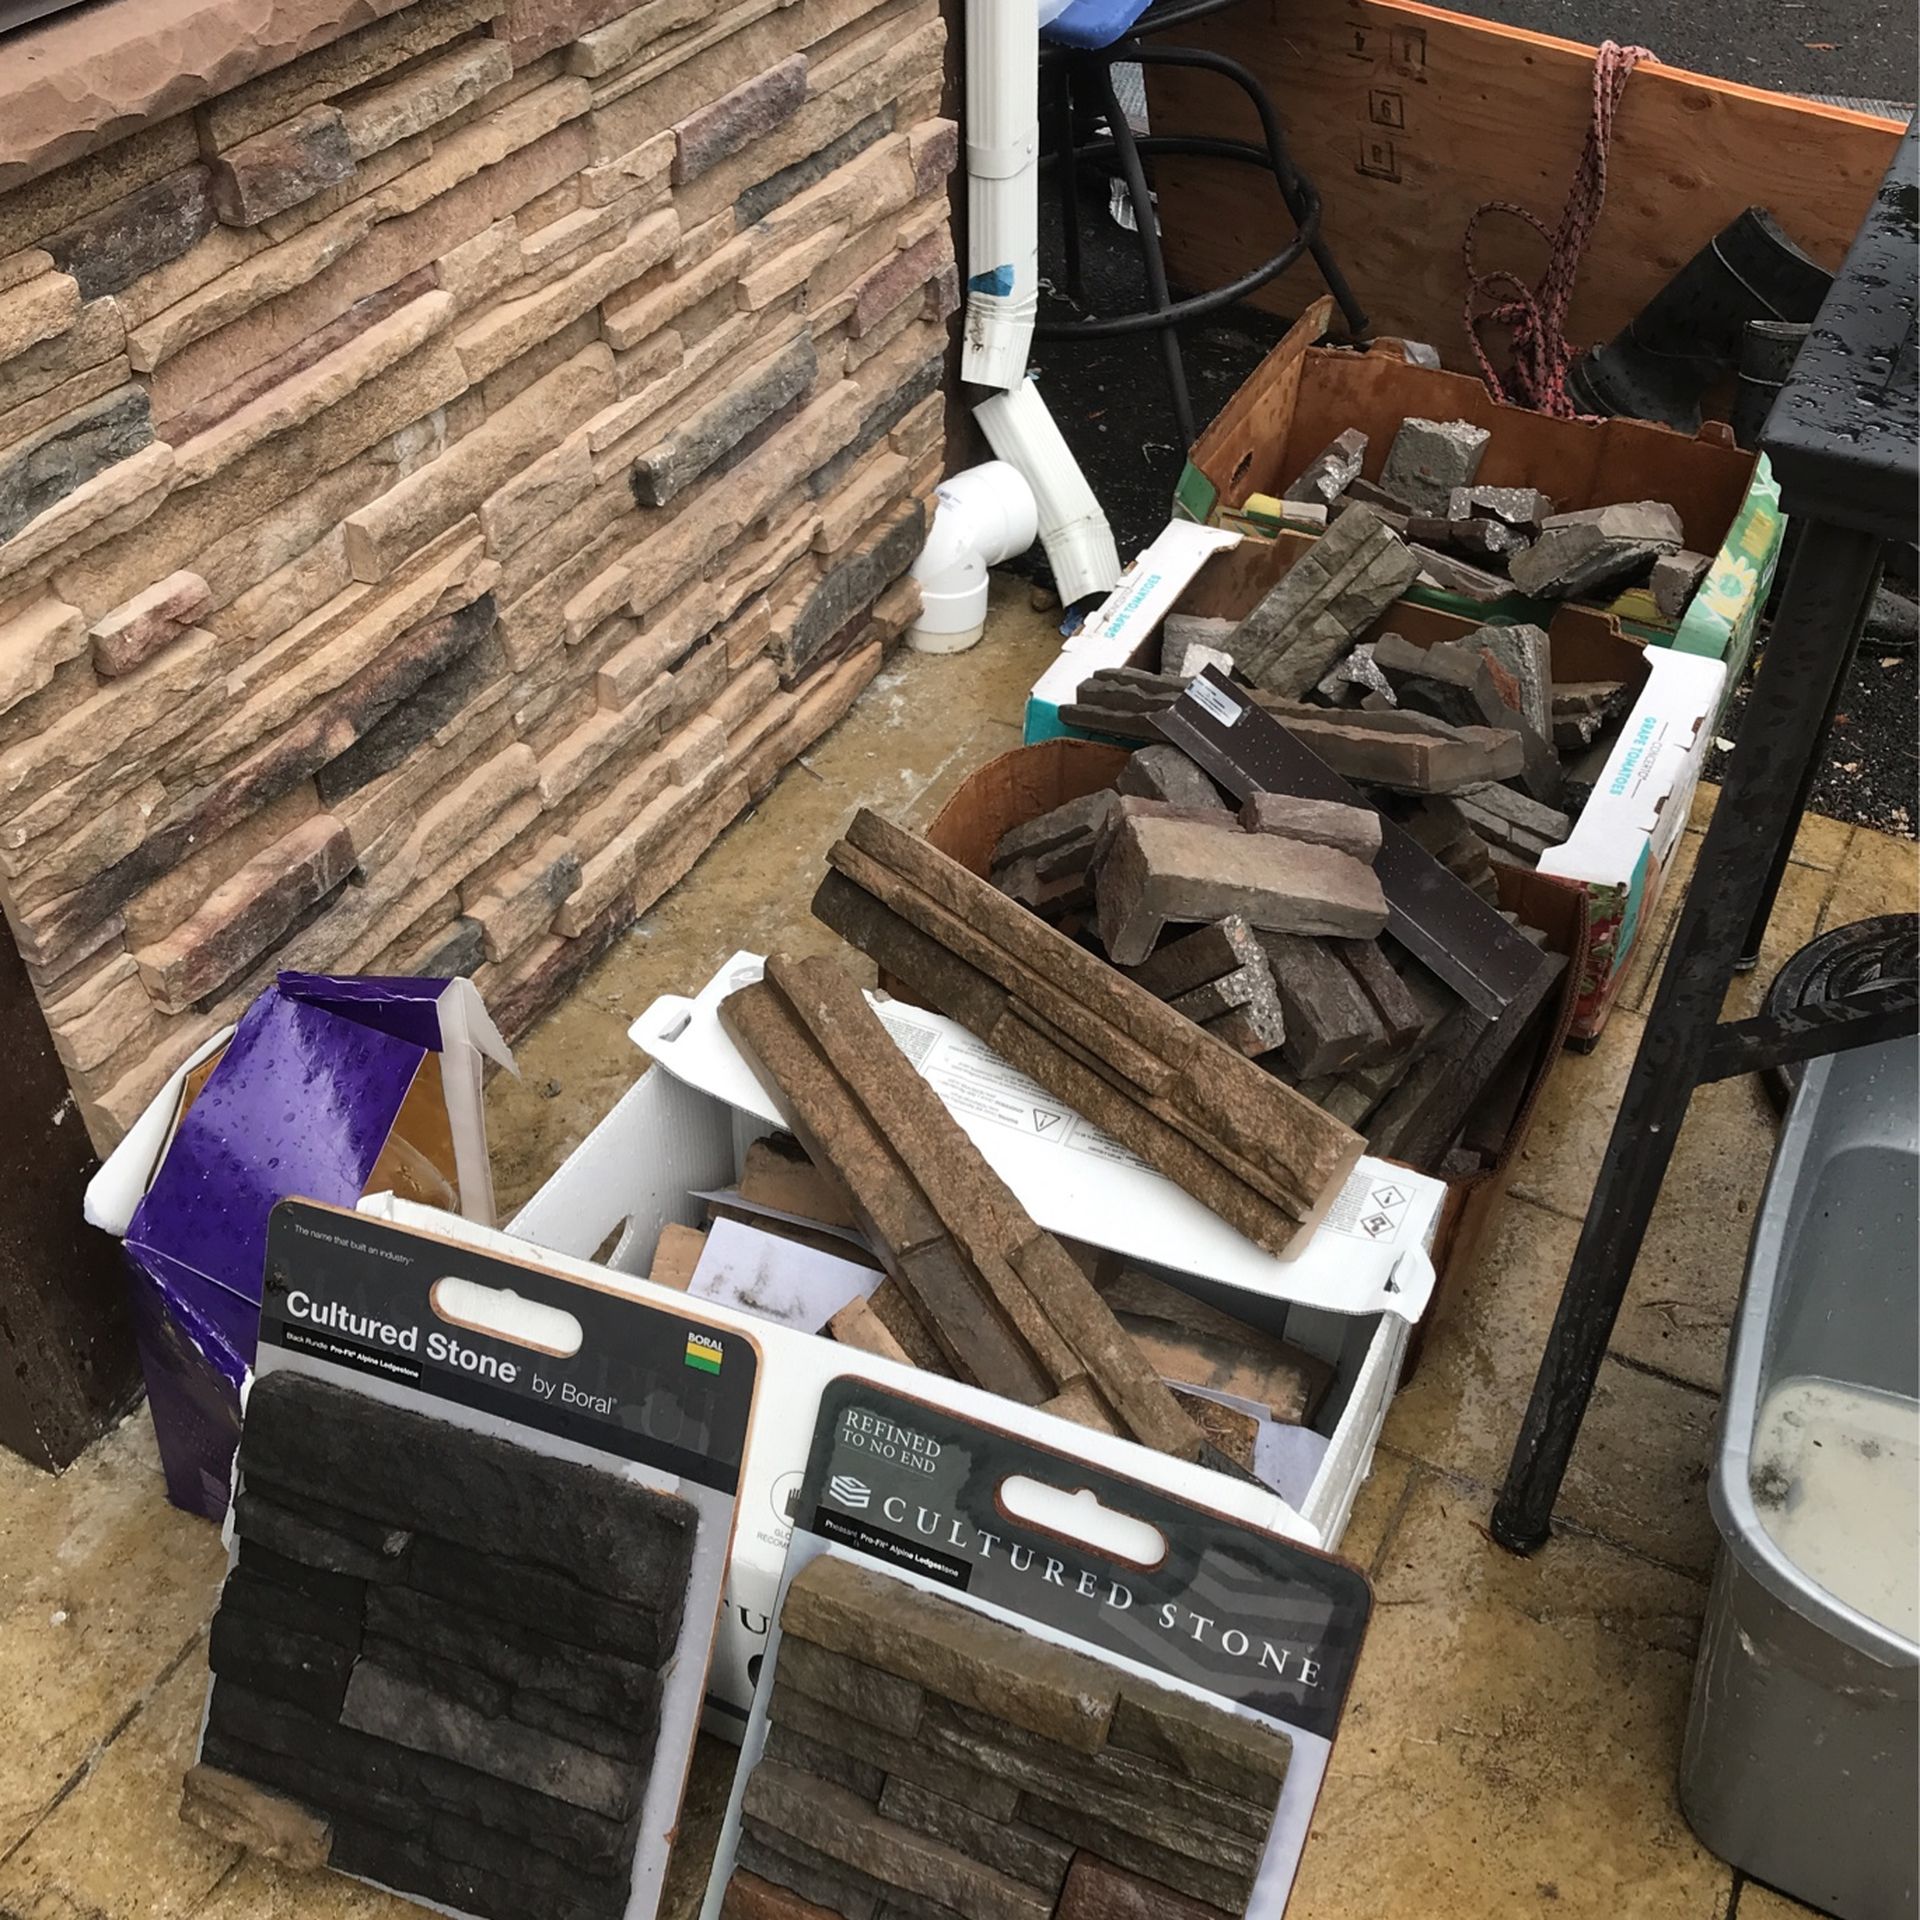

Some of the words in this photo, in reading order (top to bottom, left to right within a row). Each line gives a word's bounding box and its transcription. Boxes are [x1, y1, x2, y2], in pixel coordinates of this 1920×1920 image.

[1633, 716, 1657, 746] GRAPE
[1609, 745, 1643, 796] TOMATOES
[295, 1224, 310, 1237] The
[310, 1229, 332, 1243] name
[333, 1235, 349, 1248] that
[350, 1239, 367, 1253] built
[367, 1245, 378, 1255] an
[379, 1248, 410, 1266] industry
[286, 1291, 418, 1353] Cultured
[426, 1333, 517, 1384] Stone
[532, 1373, 556, 1398] by
[562, 1381, 612, 1415] Boral
[688, 1332, 723, 1350] BORAL
[356, 1352, 378, 1366] Alpine
[378, 1358, 419, 1378] Ledgestone
[842, 1429, 868, 1447] TO
[869, 1437, 895, 1460] NO
[900, 1448, 936, 1474] END
[845, 1410, 941, 1458] REFINED
[825, 1519, 858, 1539] Pheasant
[889, 1542, 914, 1560] Alpine
[914, 1550, 960, 1578] Ledgestone
[883, 1497, 1133, 1612] CULTURED
[1158, 1602, 1320, 1689] STONE
